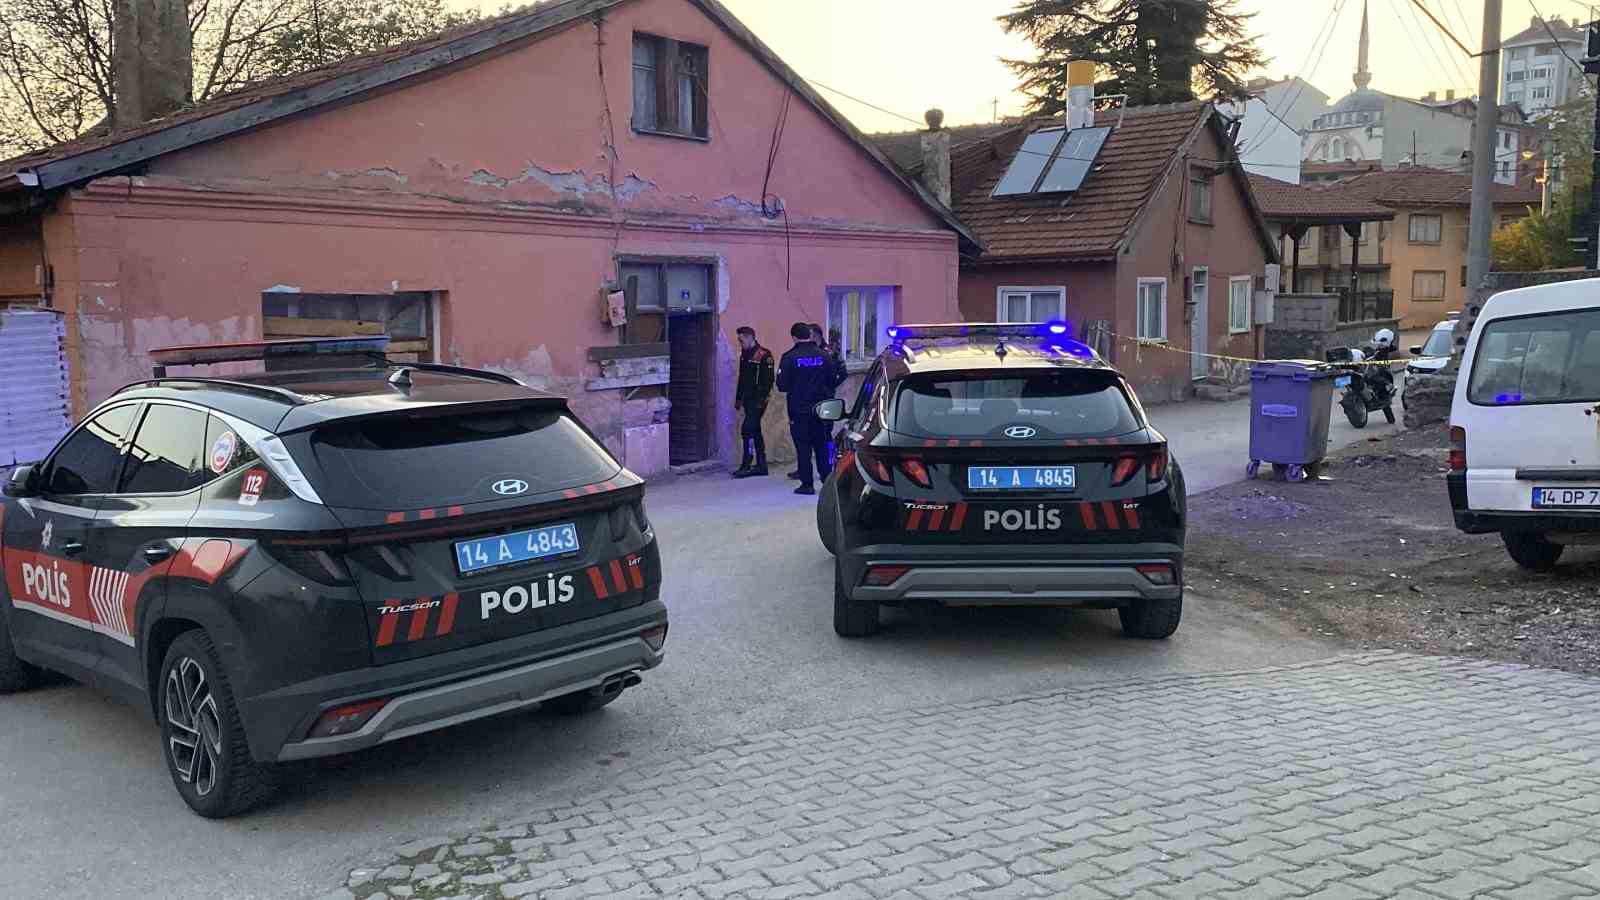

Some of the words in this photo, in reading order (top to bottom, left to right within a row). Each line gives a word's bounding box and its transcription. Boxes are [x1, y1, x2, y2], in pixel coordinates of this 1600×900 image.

[246, 475, 262, 492] 112
[980, 469, 997, 486] 14
[1012, 469, 1021, 486] A
[1035, 469, 1072, 486] 4845
[1542, 490, 1555, 503] 14
[1563, 490, 1585, 503] DP
[983, 503, 1062, 531] POLİS
[462, 543, 489, 567] 14
[498, 539, 513, 561] A
[527, 527, 575, 553] 4843
[22, 561, 70, 608] POLİS
[481, 573, 575, 619] POLİS
